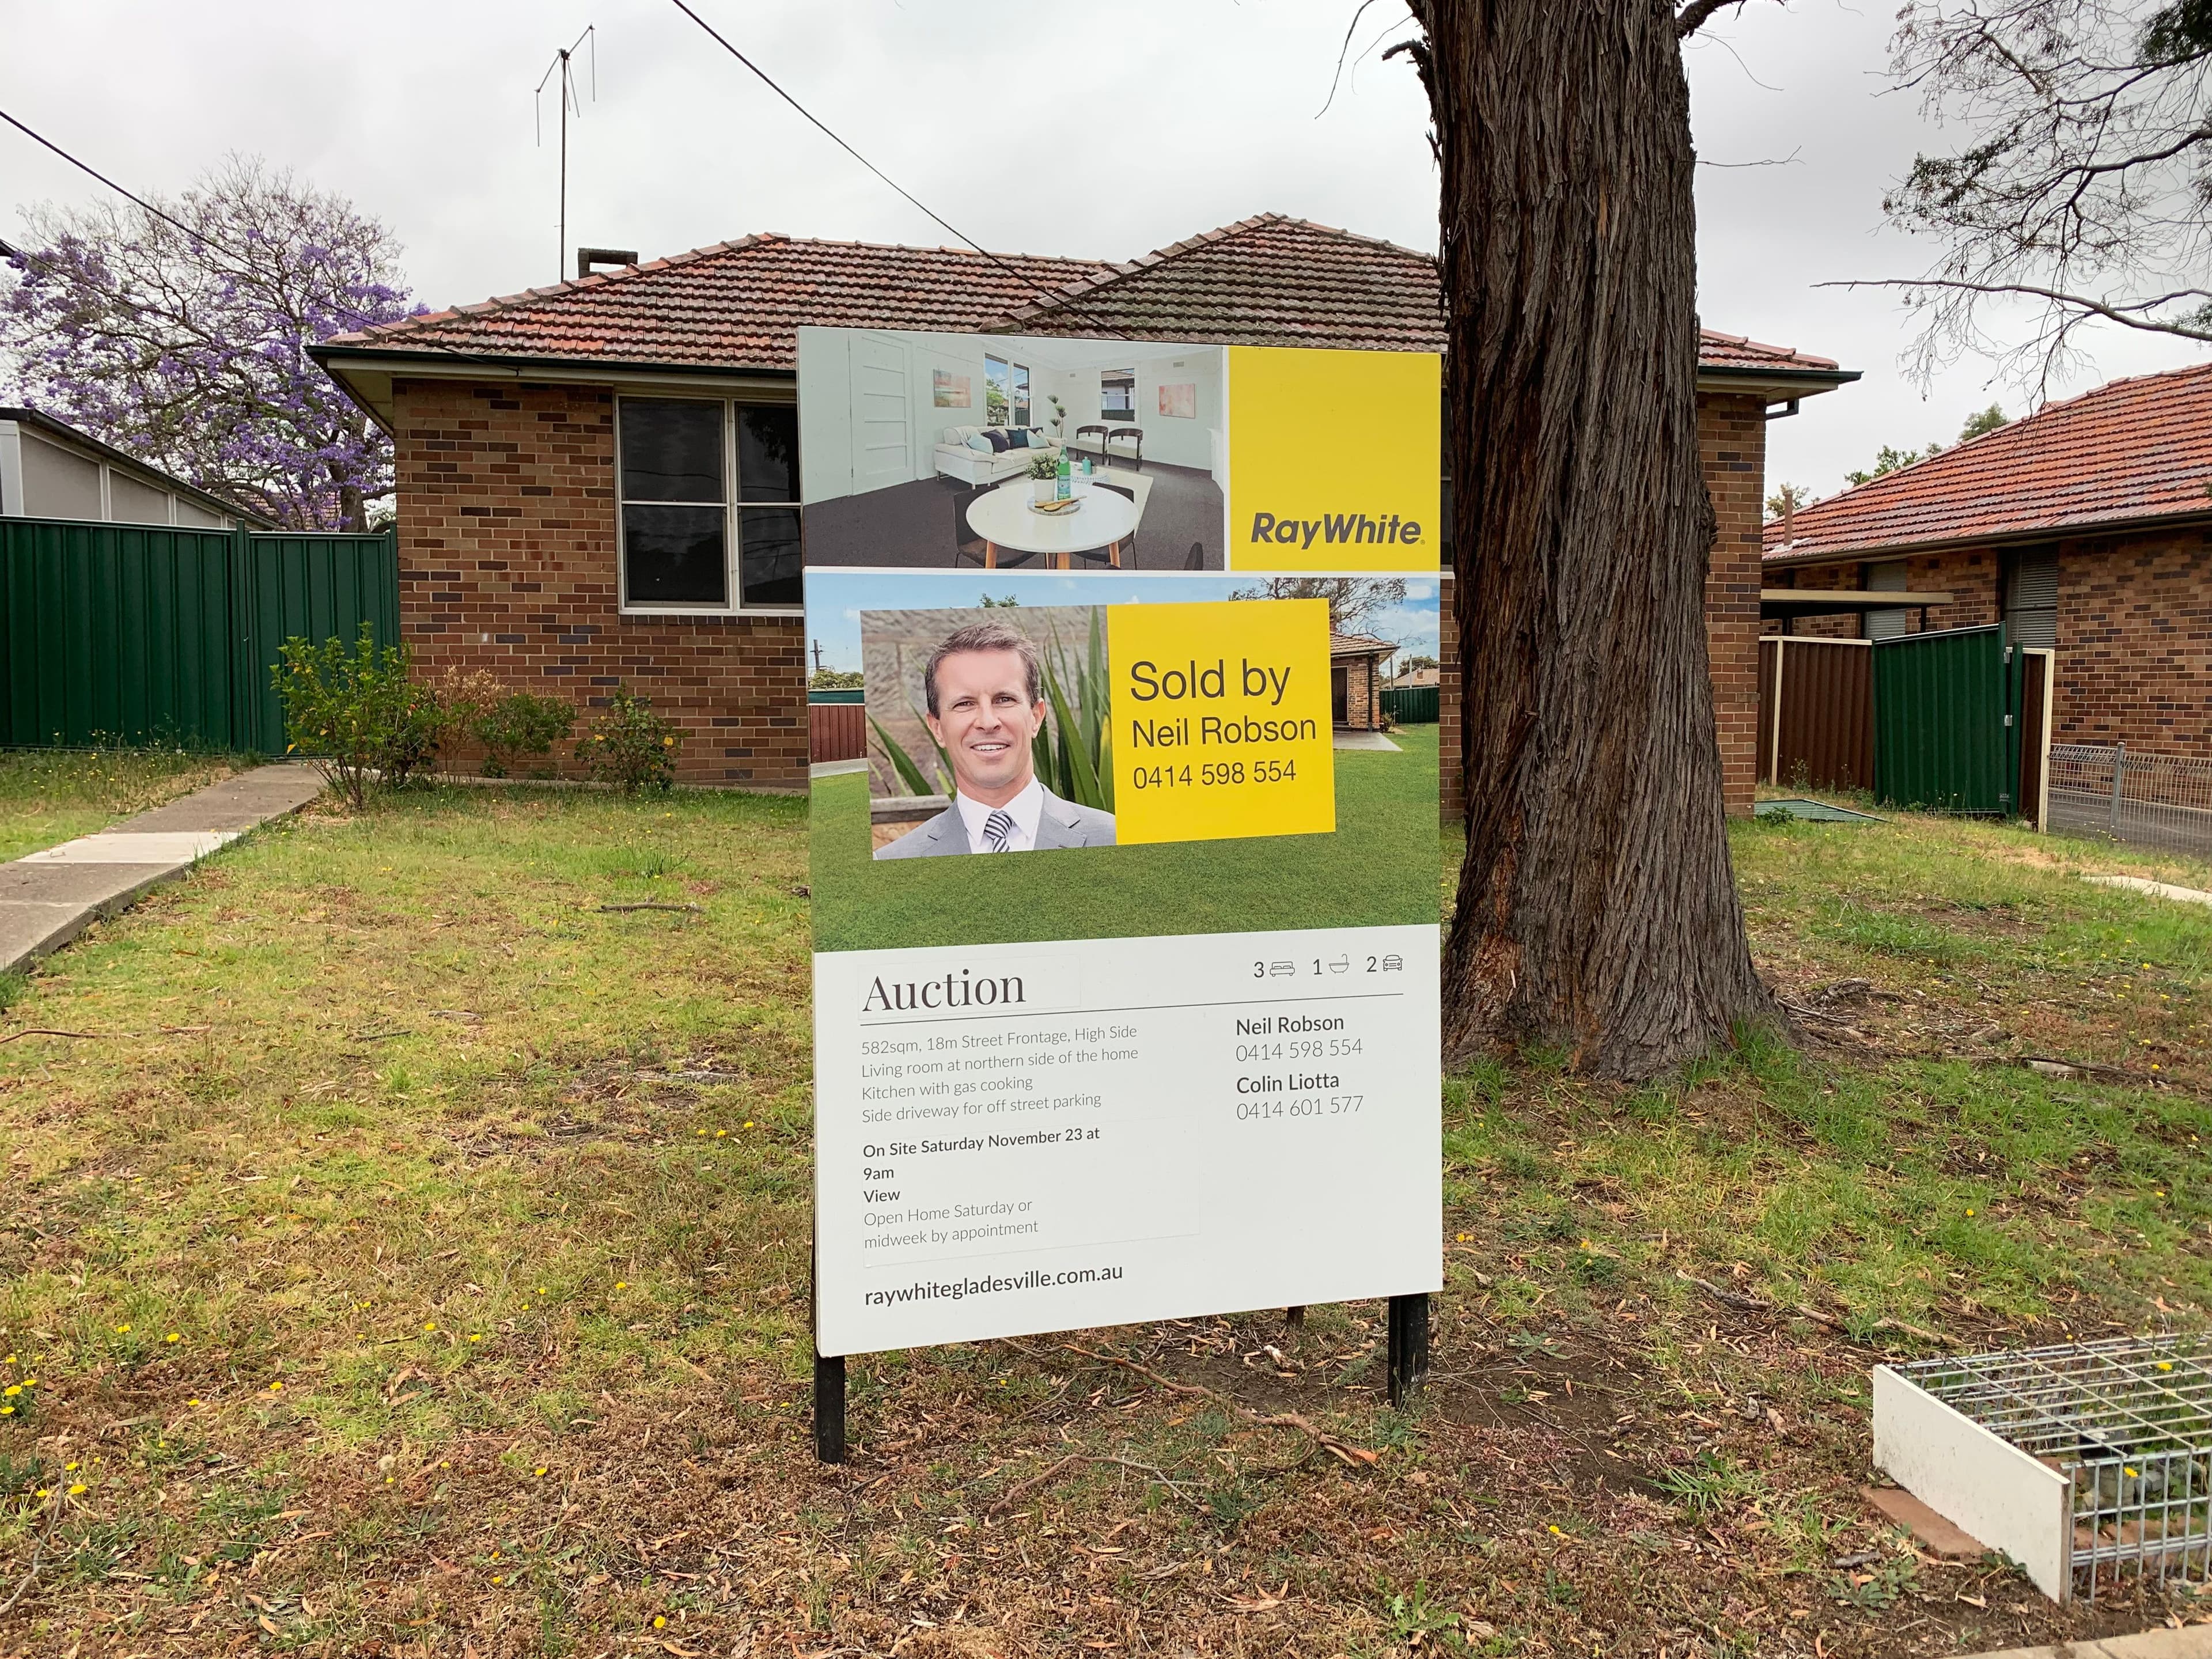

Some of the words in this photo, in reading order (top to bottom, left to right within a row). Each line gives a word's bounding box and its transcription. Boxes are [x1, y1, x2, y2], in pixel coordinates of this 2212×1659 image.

[1251, 512, 1422, 550] RayWhite
[1130, 658, 1225, 702] Sold
[1242, 658, 1291, 706] by
[1132, 718, 1188, 748] Neil
[1201, 715, 1316, 745] Robson
[1134, 764, 1193, 789] 0414
[1202, 762, 1245, 786] 598
[1253, 759, 1297, 783] 554
[1253, 961, 1264, 978] 3
[1313, 959, 1323, 975] 1
[1366, 956, 1377, 973] 2
[862, 968, 1027, 1012] Auction
[861, 1040, 922, 1055] 582sqm,
[927, 1037, 957, 1051] 18m
[961, 1034, 1003, 1048] Street
[1007, 1031, 1070, 1046] Frontage,
[1075, 1027, 1105, 1043] High
[1109, 1025, 1137, 1039] Side
[1237, 1017, 1271, 1036] Neil
[1278, 1015, 1344, 1033] Robson
[862, 1063, 903, 1078] Living
[907, 1062, 943, 1074] room
[947, 1059, 961, 1071] at
[965, 1055, 1024, 1070] northern
[1028, 1052, 1055, 1066] side
[1059, 1050, 1073, 1064] of
[1076, 1049, 1098, 1063] the
[1102, 1048, 1138, 1060] home
[1236, 1043, 1283, 1062] 0414
[1289, 1040, 1323, 1059] 598
[1330, 1038, 1363, 1056] 554
[862, 1085, 915, 1100] Kitchen
[919, 1081, 949, 1096] with
[953, 1082, 976, 1096] gas
[980, 1076, 1033, 1092] cooking
[1237, 1075, 1282, 1094] Colin
[1289, 1073, 1339, 1090] Liotta
[862, 1108, 892, 1123] Side
[896, 1106, 959, 1120] driveway
[963, 1101, 983, 1115] for
[987, 1099, 1006, 1113] off
[1010, 1097, 1050, 1111] street
[1054, 1093, 1101, 1111] parking
[1237, 1101, 1284, 1120] 0414
[1290, 1098, 1323, 1116] 601
[1330, 1095, 1363, 1113] 577
[863, 1145, 885, 1158] On
[889, 1142, 917, 1156] Site
[921, 1137, 984, 1153] Saturday
[988, 1130, 1062, 1148] November
[1065, 1128, 1082, 1142] 23
[1086, 1127, 1100, 1140] at
[863, 1168, 894, 1181] 9am
[863, 1189, 900, 1203] View
[864, 1213, 903, 1228] Open
[908, 1208, 950, 1222] Home
[954, 1200, 1014, 1218] Saturday
[1018, 1201, 1033, 1211] or
[865, 1230, 927, 1249] midweek
[931, 1229, 948, 1244] by
[952, 1221, 1039, 1243] appointment
[865, 1266, 1123, 1307] raywhitegladesville.com.au
